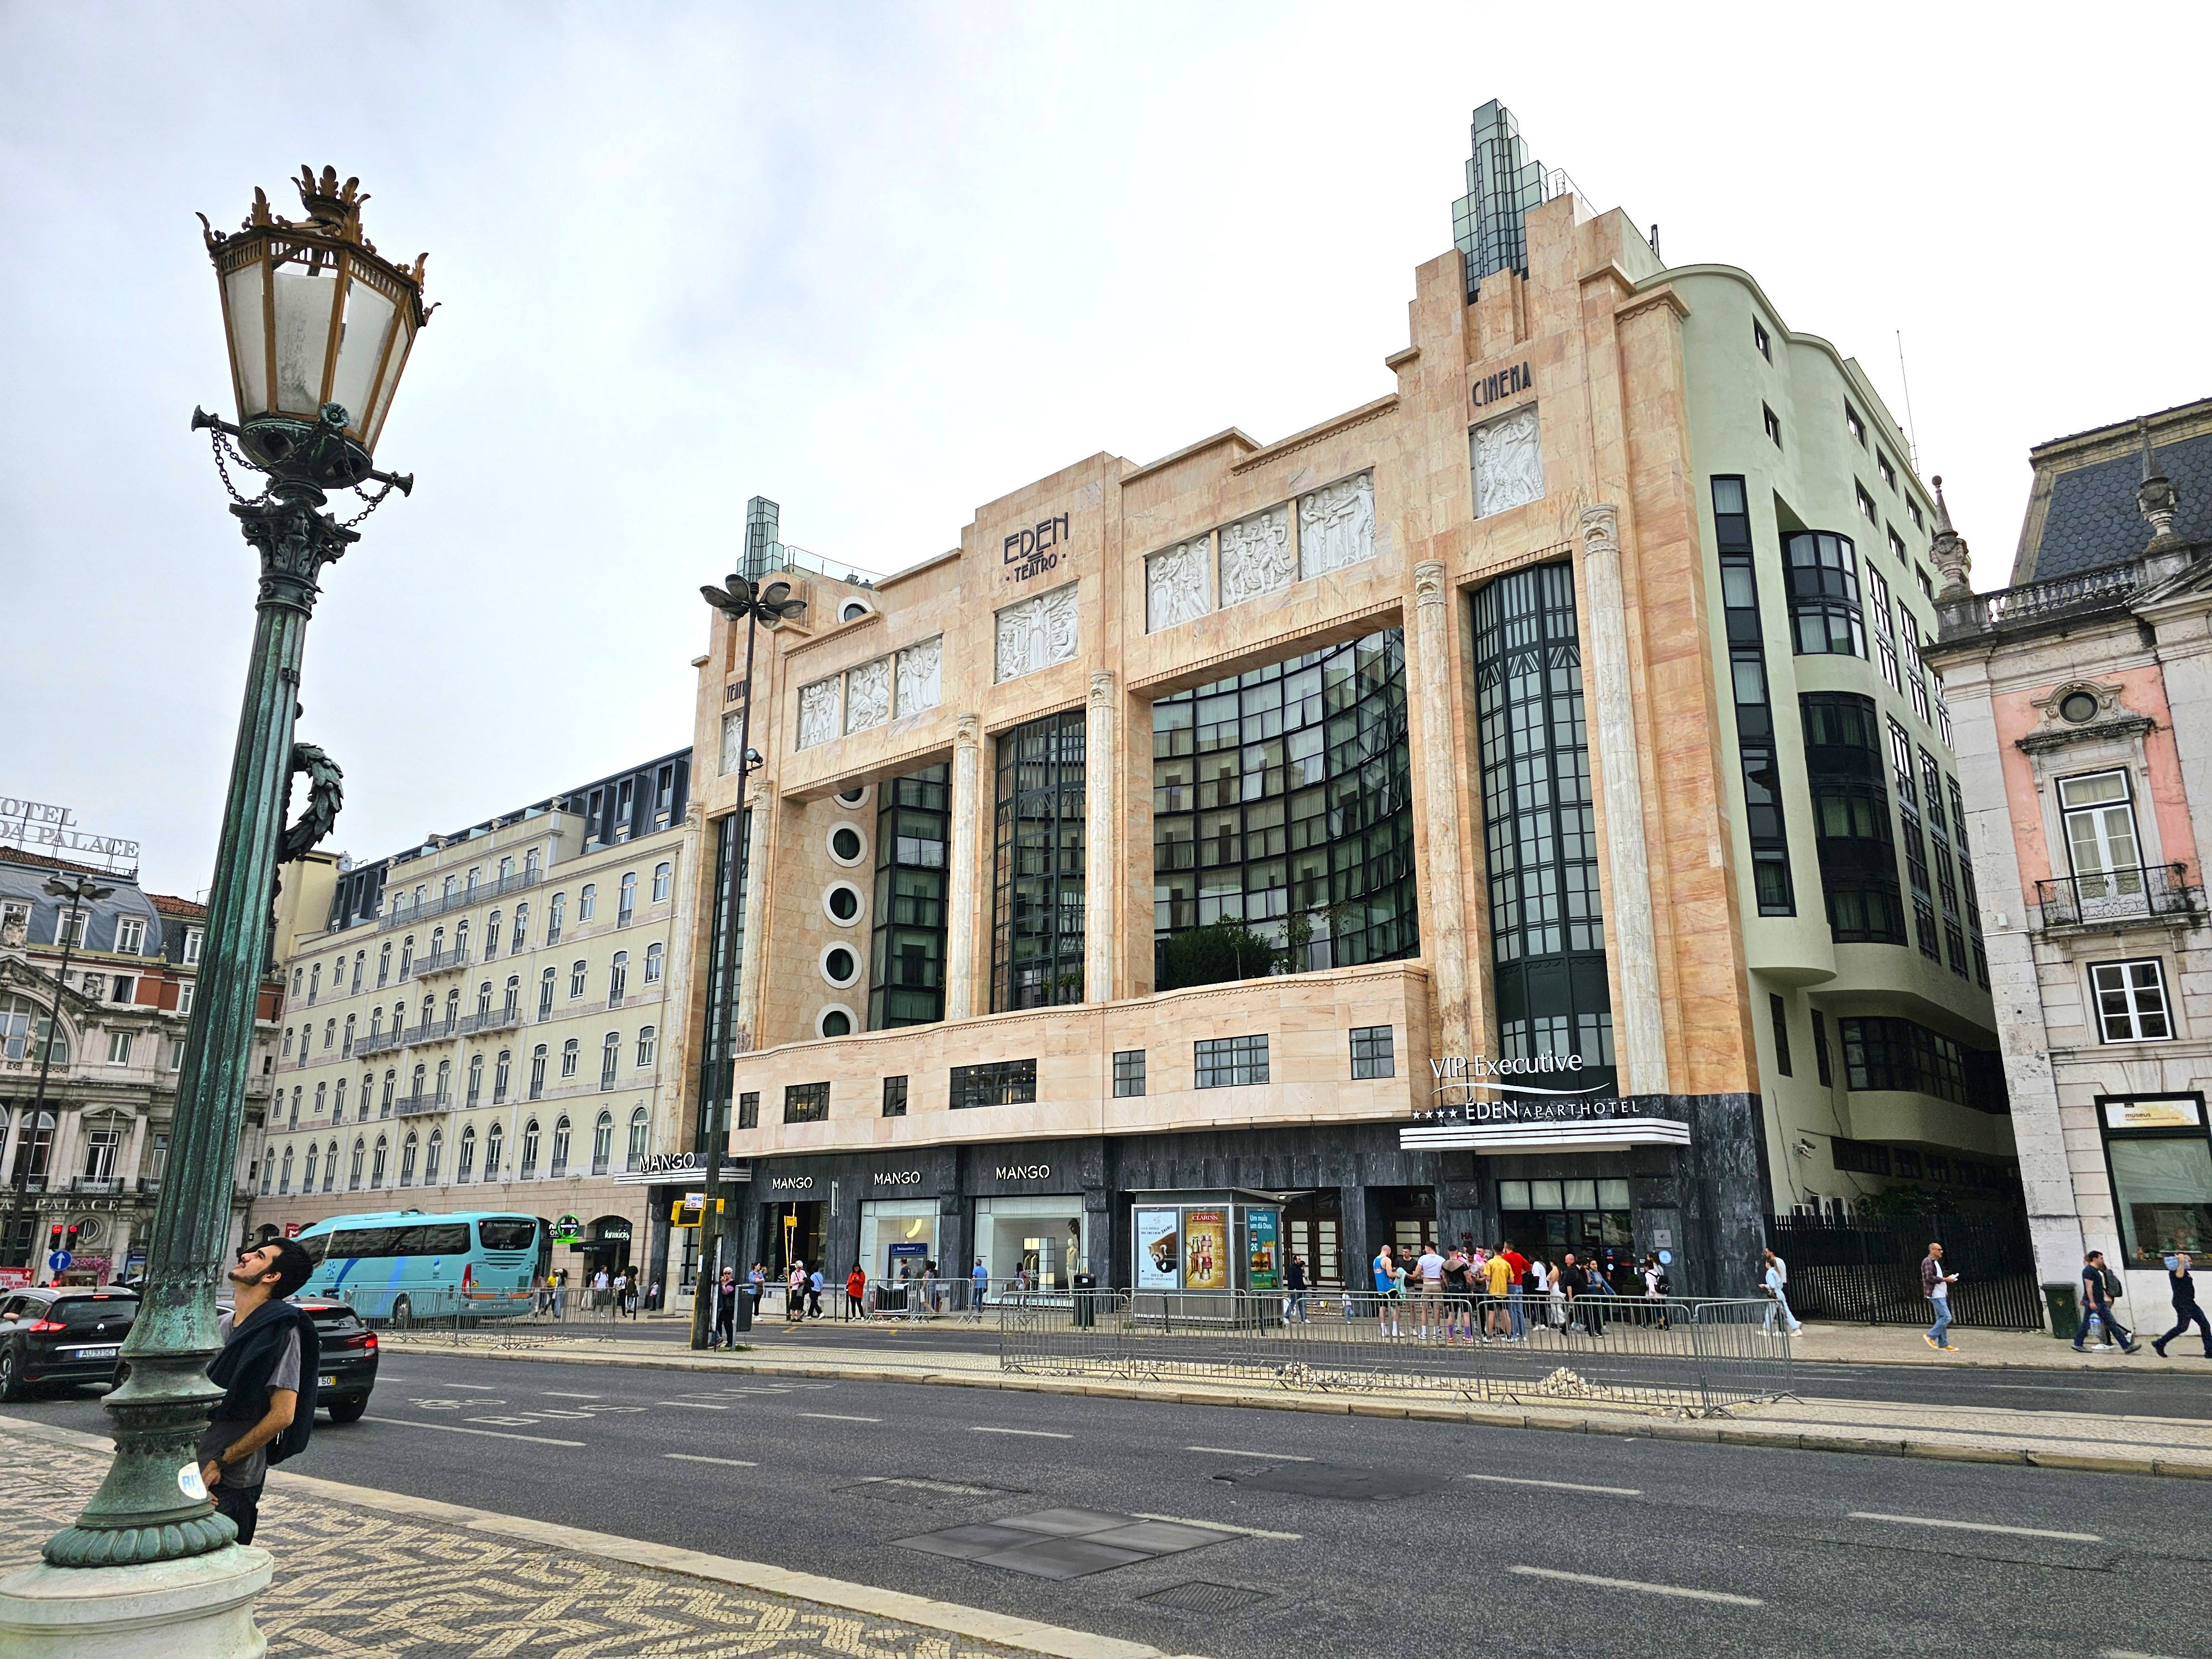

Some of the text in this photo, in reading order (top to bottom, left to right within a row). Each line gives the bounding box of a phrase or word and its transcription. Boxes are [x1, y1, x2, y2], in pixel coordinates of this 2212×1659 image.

[1472, 361, 1531, 406] CINEMA
[1004, 512, 1068, 565] EDEN
[1014, 553, 1057, 582] TEATRO
[36, 826, 140, 858] PALACE
[1429, 1050, 1583, 1079] VIP Executive
[1466, 1098, 1640, 1120] ÉDEN APARTHOTEL
[639, 1151, 695, 1171] MANGO
[772, 1176, 813, 1190] MANGO
[874, 1171, 920, 1185] MANGO
[996, 1165, 1050, 1180] MANGO
[35, 1198, 119, 1211] PALACE
[1250, 1243, 1258, 1251] 2€
[462, 1405, 649, 1426] BUS
